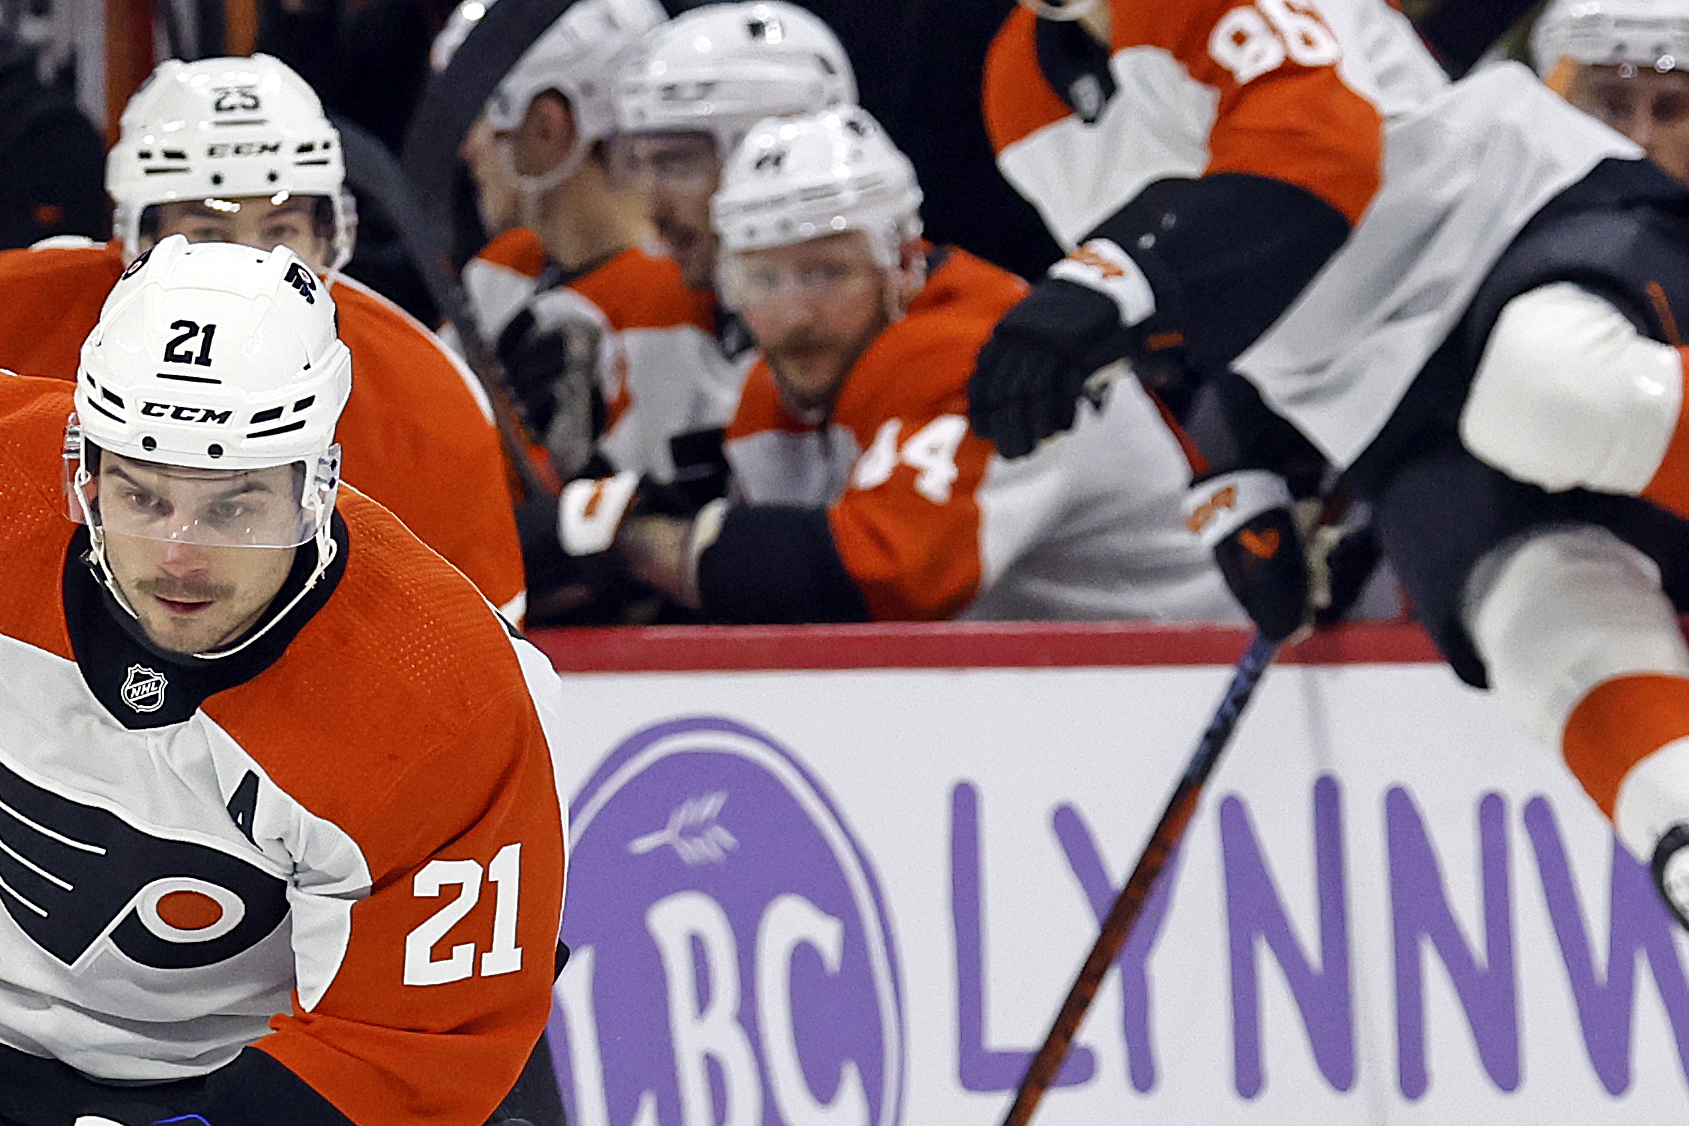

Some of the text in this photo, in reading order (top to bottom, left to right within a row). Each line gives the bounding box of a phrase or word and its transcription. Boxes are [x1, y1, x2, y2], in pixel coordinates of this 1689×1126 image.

[163, 319, 217, 367] 21
[140, 400, 233, 425] CCM
[130, 680, 159, 699] NHL
[402, 842, 524, 986] 21
